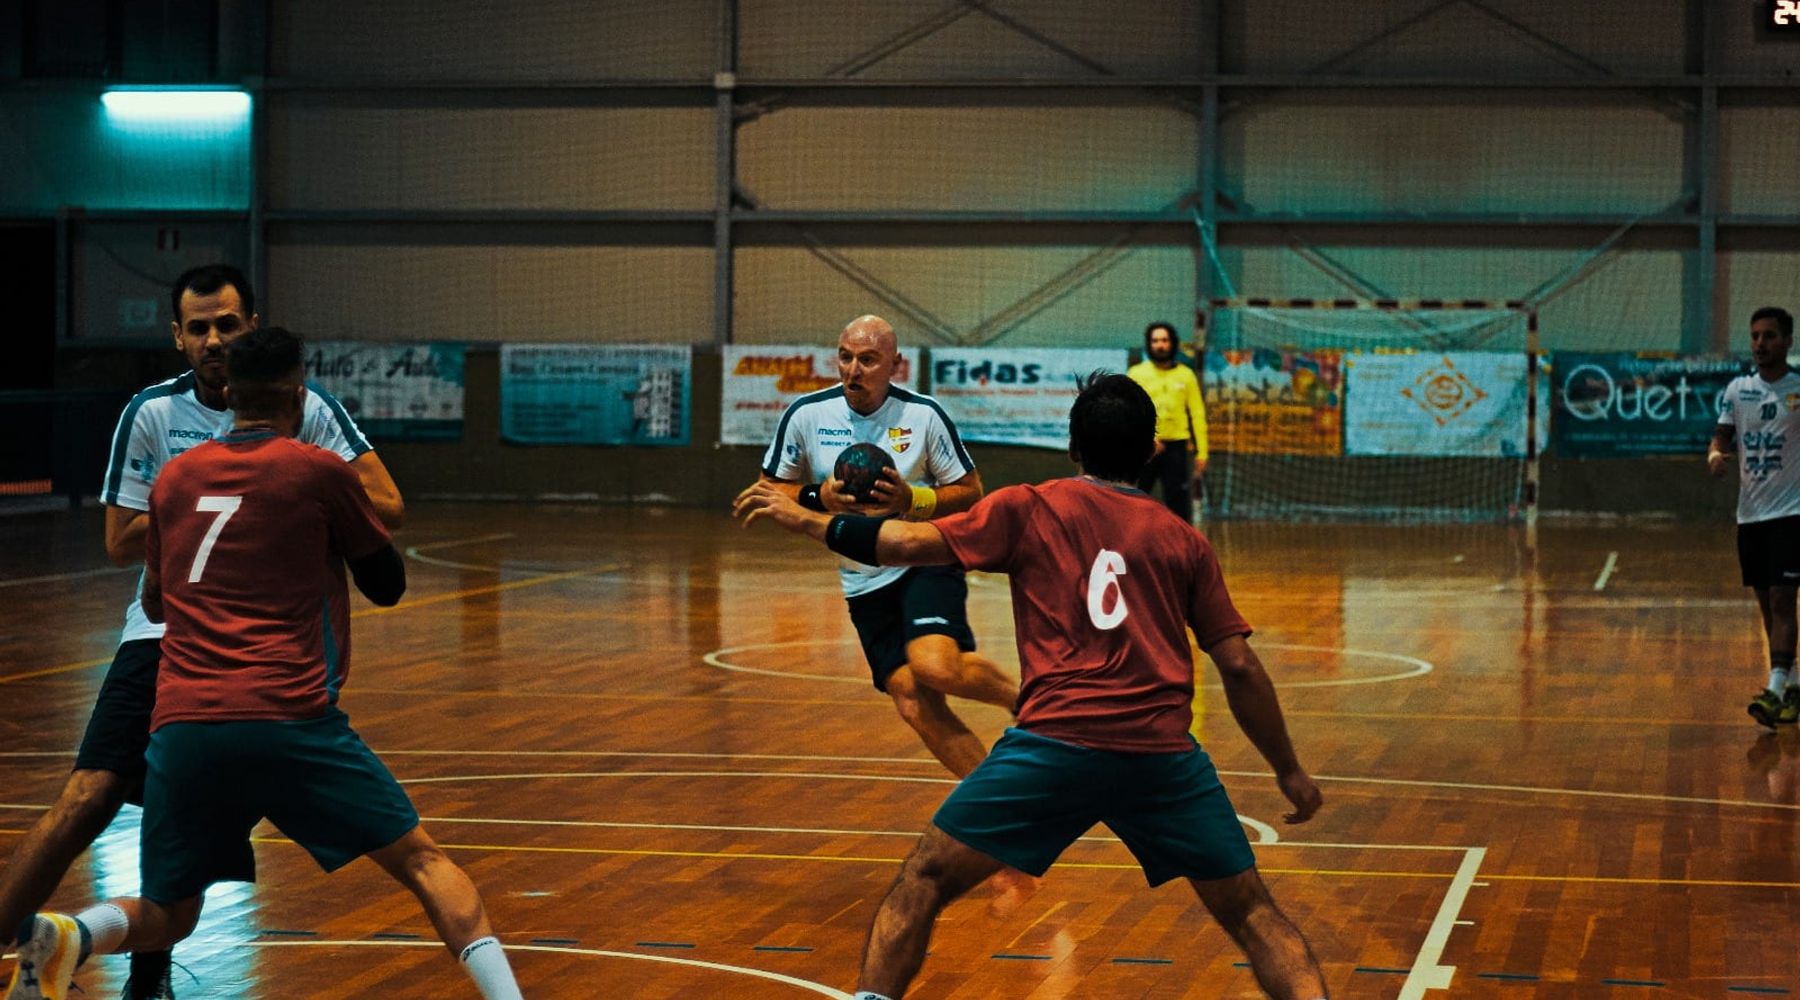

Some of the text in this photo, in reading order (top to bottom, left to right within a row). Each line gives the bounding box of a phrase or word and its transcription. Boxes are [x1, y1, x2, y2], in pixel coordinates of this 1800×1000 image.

[935, 360, 1042, 386] Fidas
[1761, 402, 1777, 420] 10
[188, 496, 243, 583] 7
[1087, 548, 1128, 630] 6
